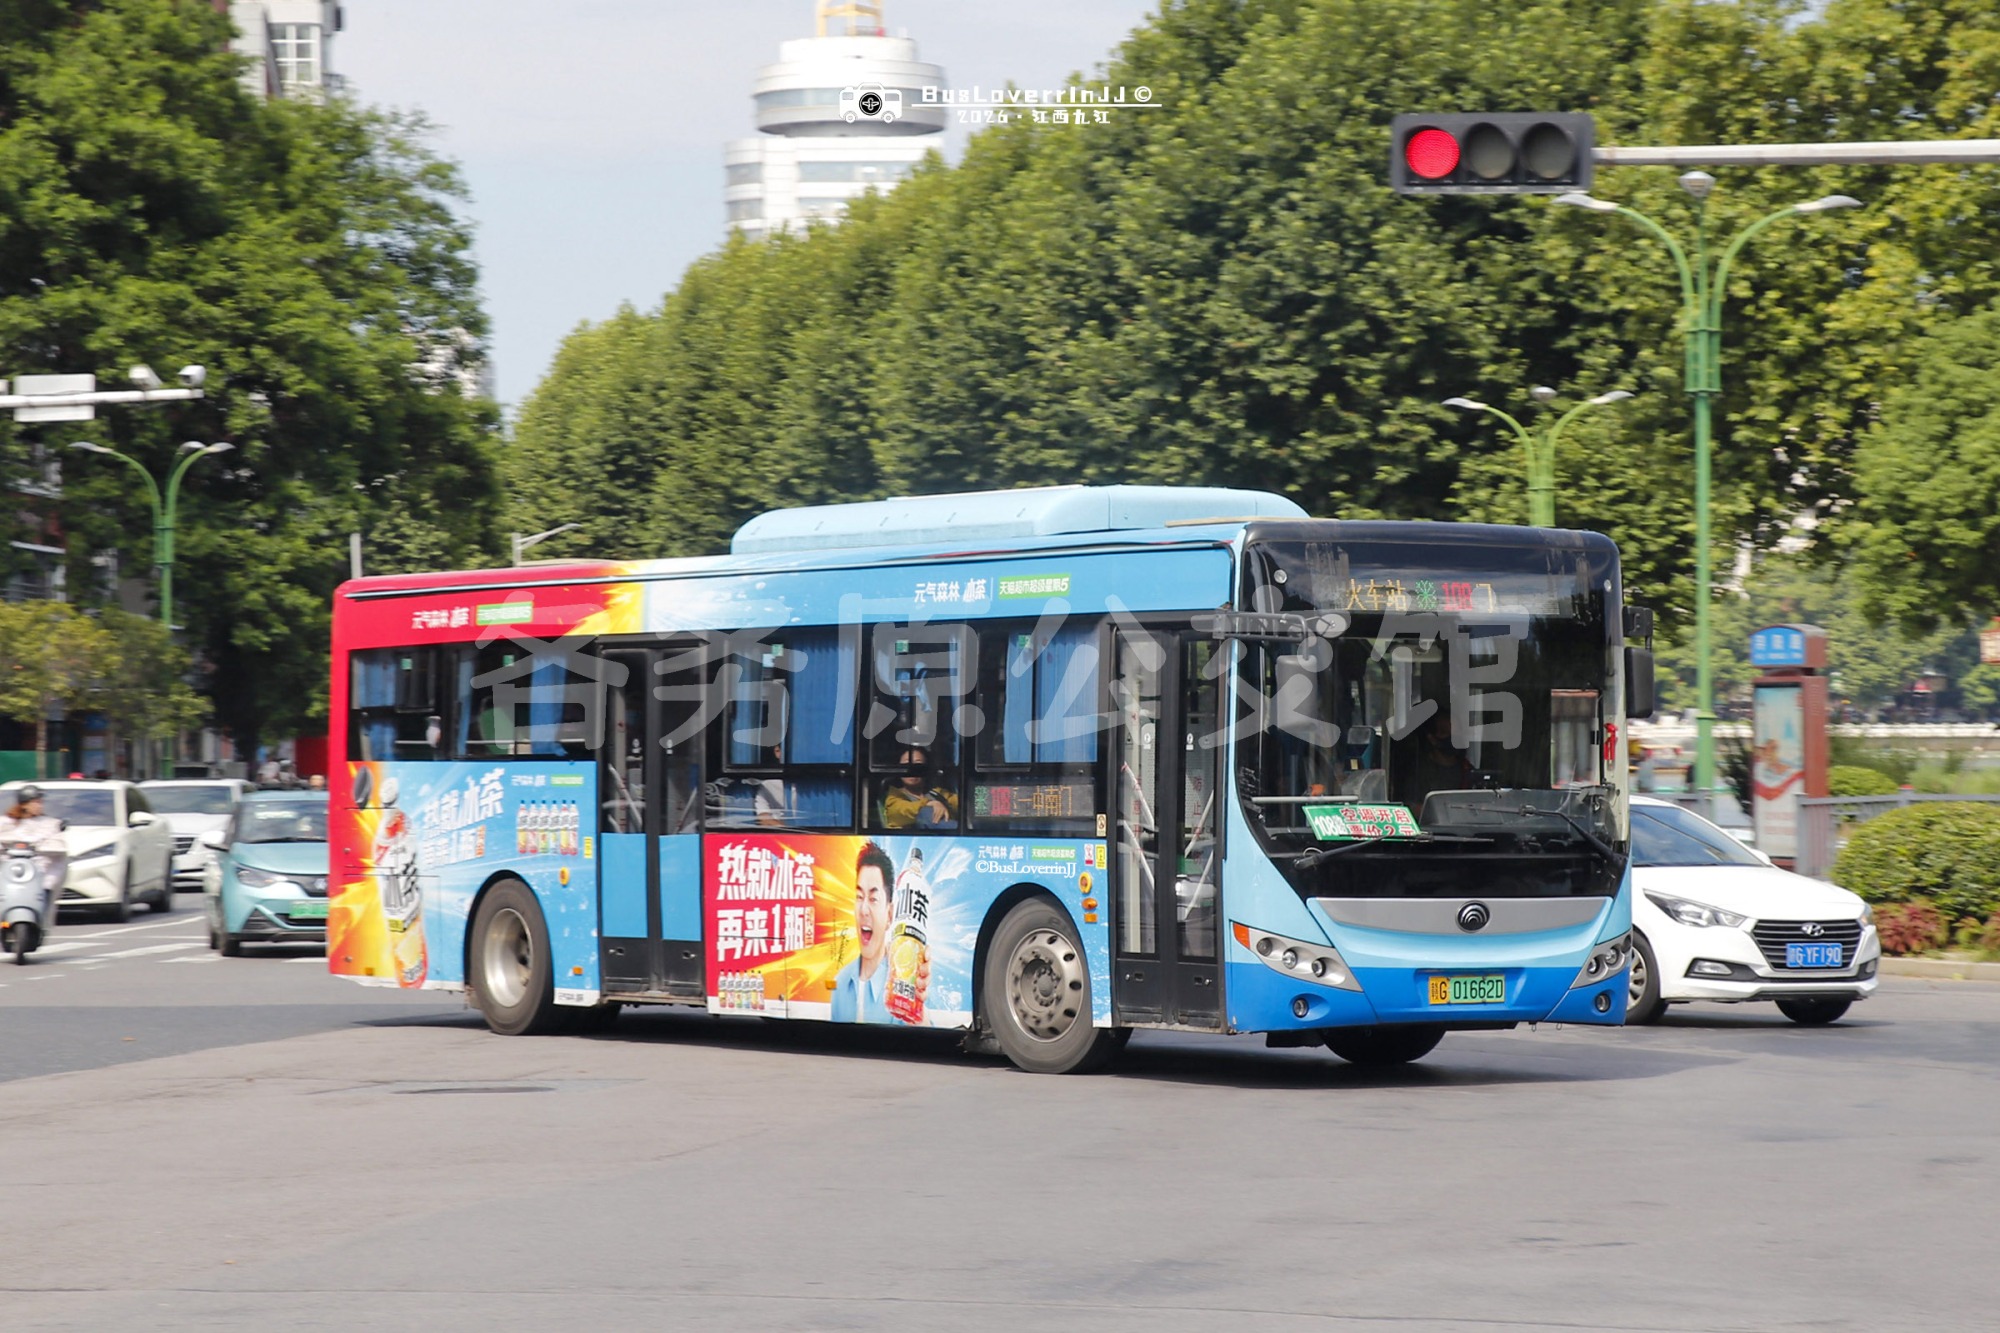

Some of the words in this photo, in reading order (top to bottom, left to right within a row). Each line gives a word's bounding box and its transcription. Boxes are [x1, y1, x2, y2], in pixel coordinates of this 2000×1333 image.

[914, 580, 960, 603] 元气森林
[1345, 578, 1407, 611] 火车站
[1441, 582, 1473, 611] 108
[1341, 808, 1412, 824] 空调开启
[716, 839, 815, 900] 热就冰茶
[716, 903, 805, 962] 再来1瓶
